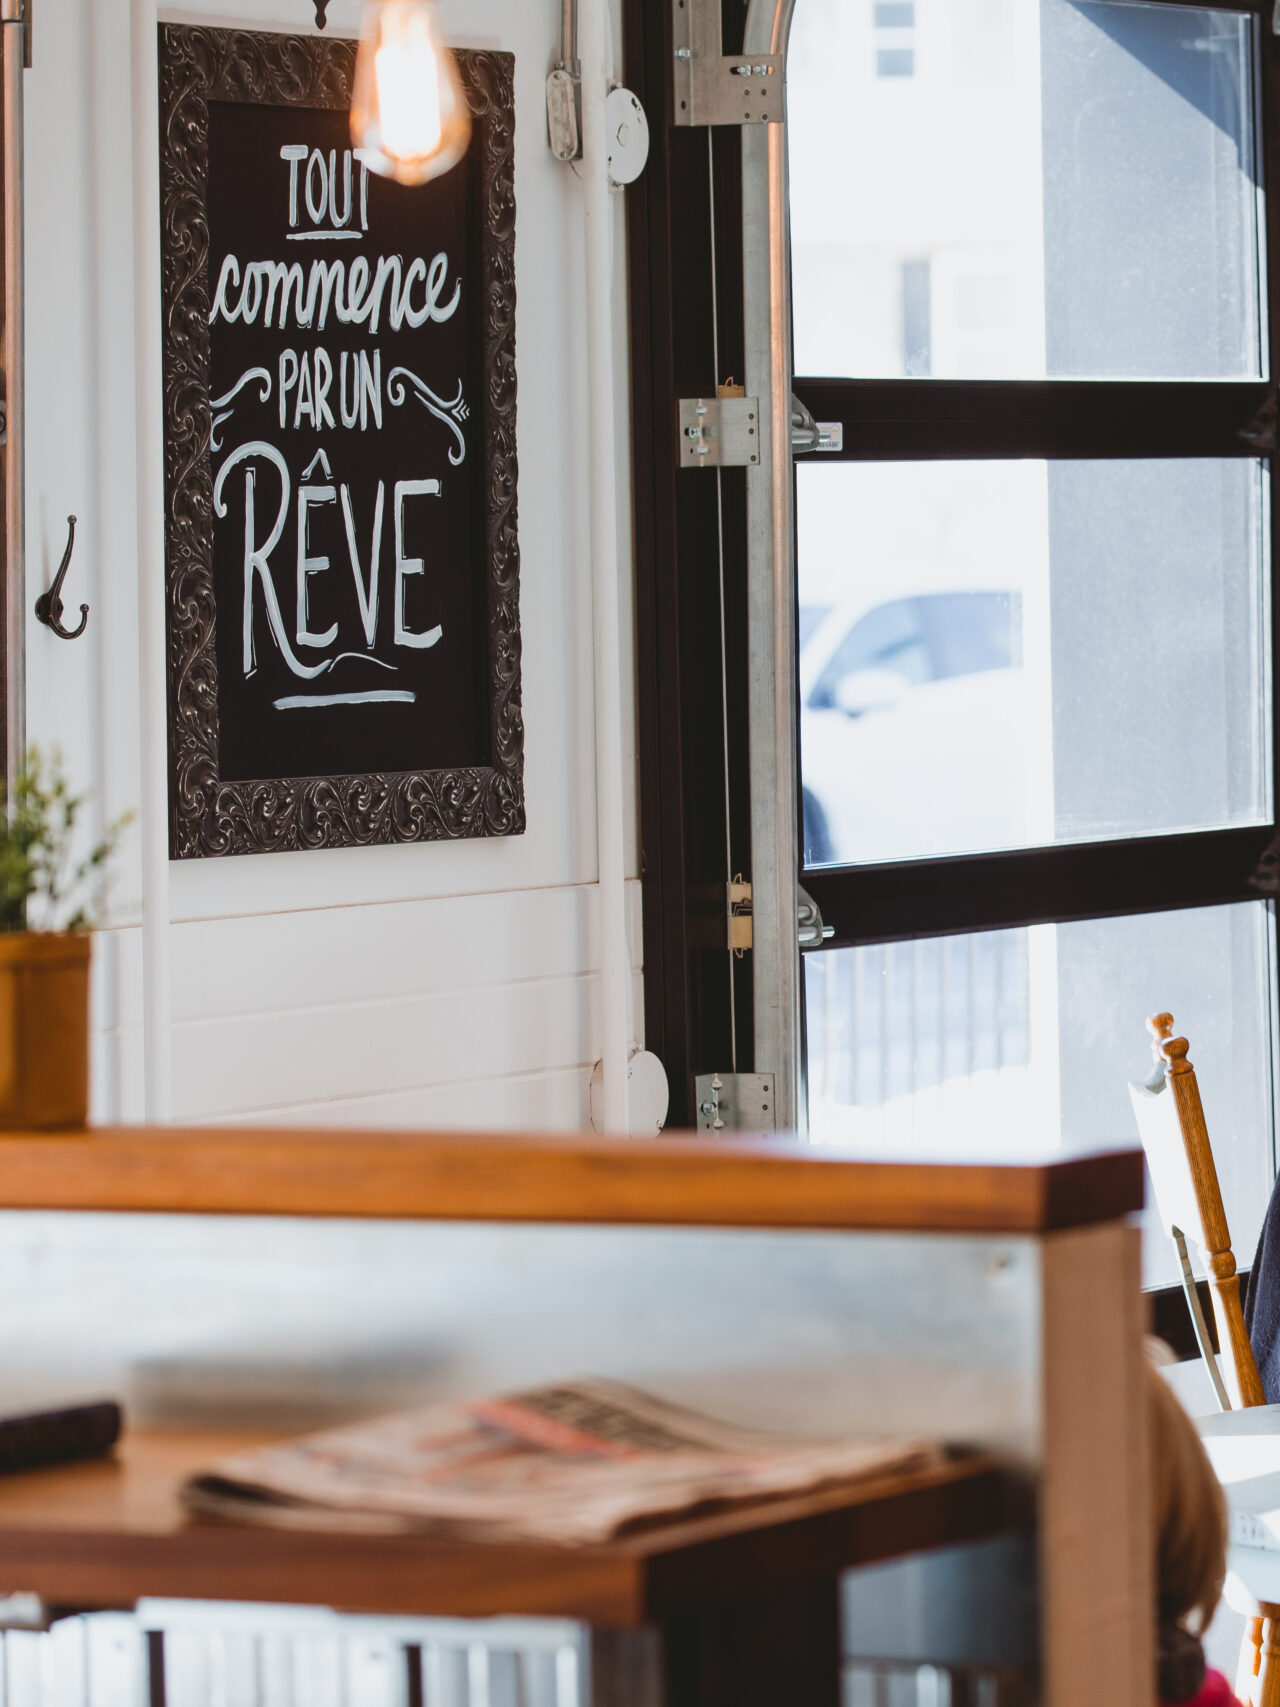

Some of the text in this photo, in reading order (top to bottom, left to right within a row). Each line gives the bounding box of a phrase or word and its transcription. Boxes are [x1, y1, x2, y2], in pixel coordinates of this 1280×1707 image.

[280, 145, 369, 231] TOUT
[209, 252, 462, 334] commence
[279, 347, 383, 431] PAR UN
[213, 440, 443, 680] RÊVE
